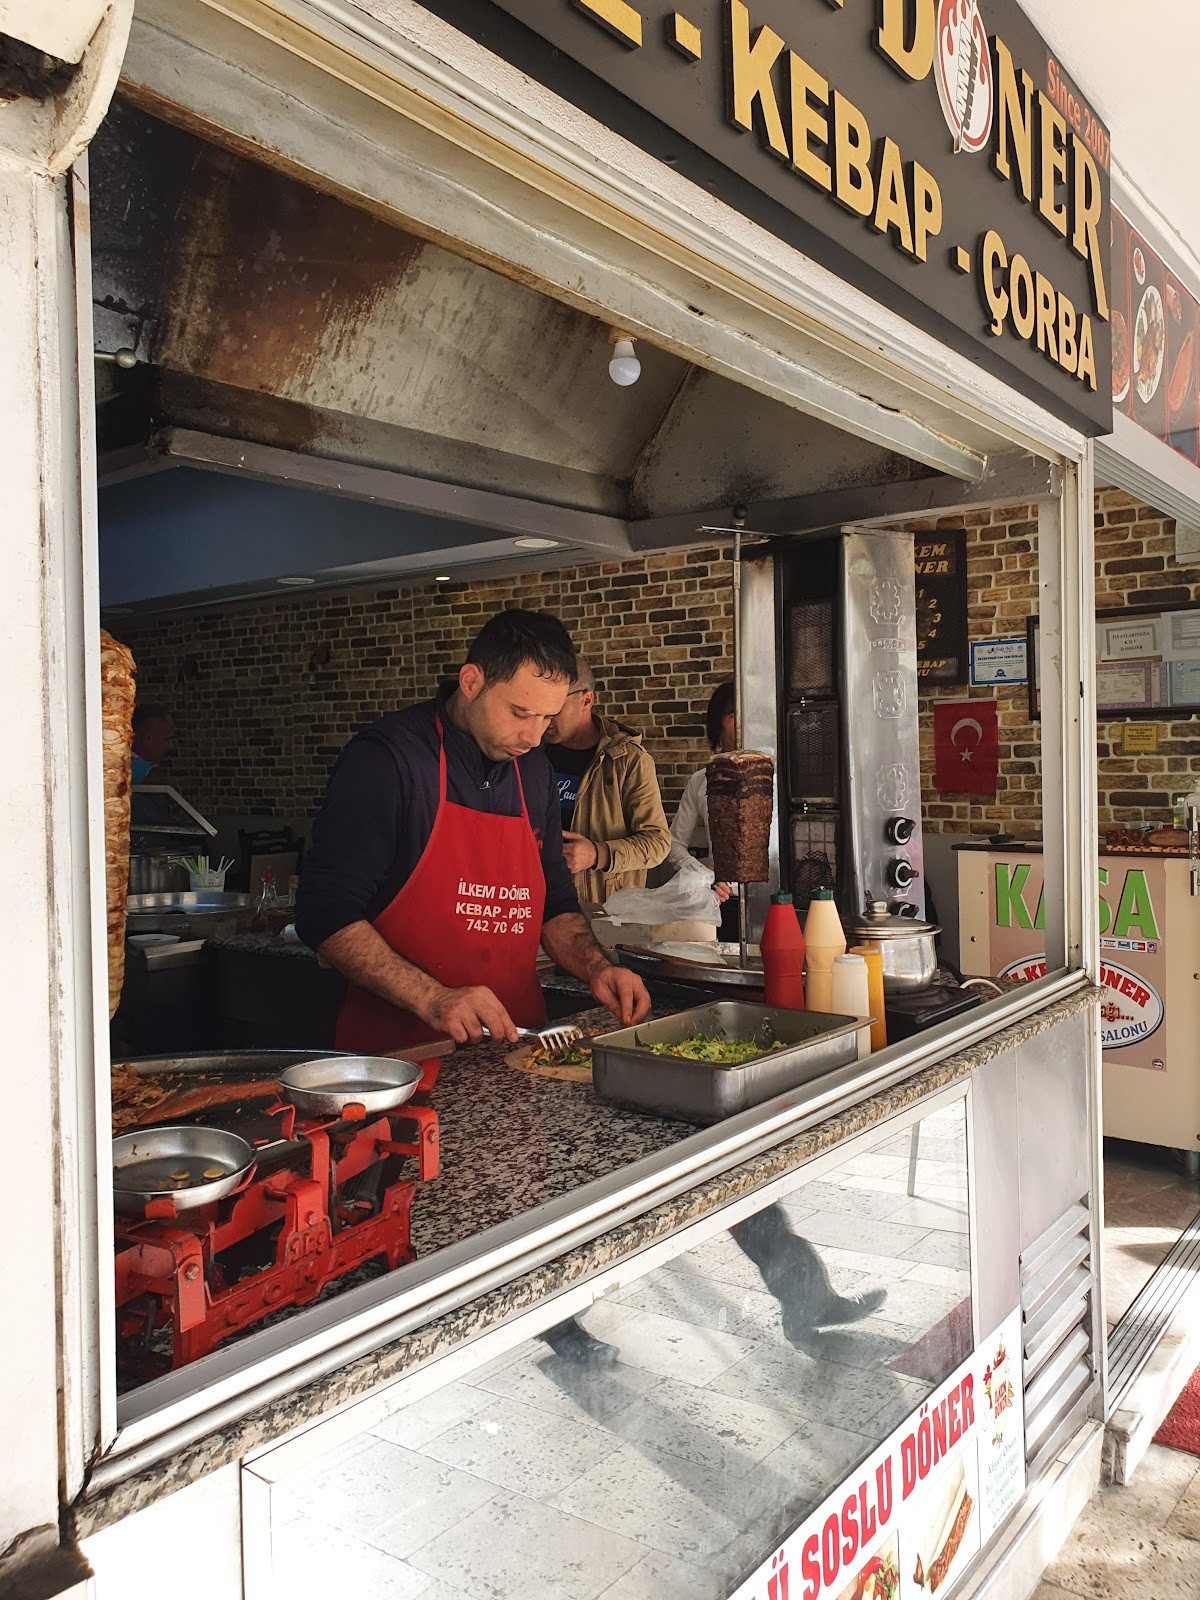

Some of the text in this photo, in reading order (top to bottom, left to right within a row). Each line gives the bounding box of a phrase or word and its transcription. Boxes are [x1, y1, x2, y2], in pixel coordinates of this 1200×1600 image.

[1047, 57, 1110, 170] Since 2007
[732, 0, 1098, 392] KEBAP ÇORBA
[928, 599, 937, 609] 2
[932, 613, 942, 623] 3
[928, 628, 937, 638] 4
[917, 641, 926, 650] 5
[457, 877, 531, 901] İLKEM DÖNER
[455, 901, 502, 918] KEBAP
[508, 903, 533, 919] PİDE
[466, 918, 525, 934] 742 70 45
[801, 1454, 893, 1600] SOSLU
[900, 1372, 975, 1502] DÖNER
